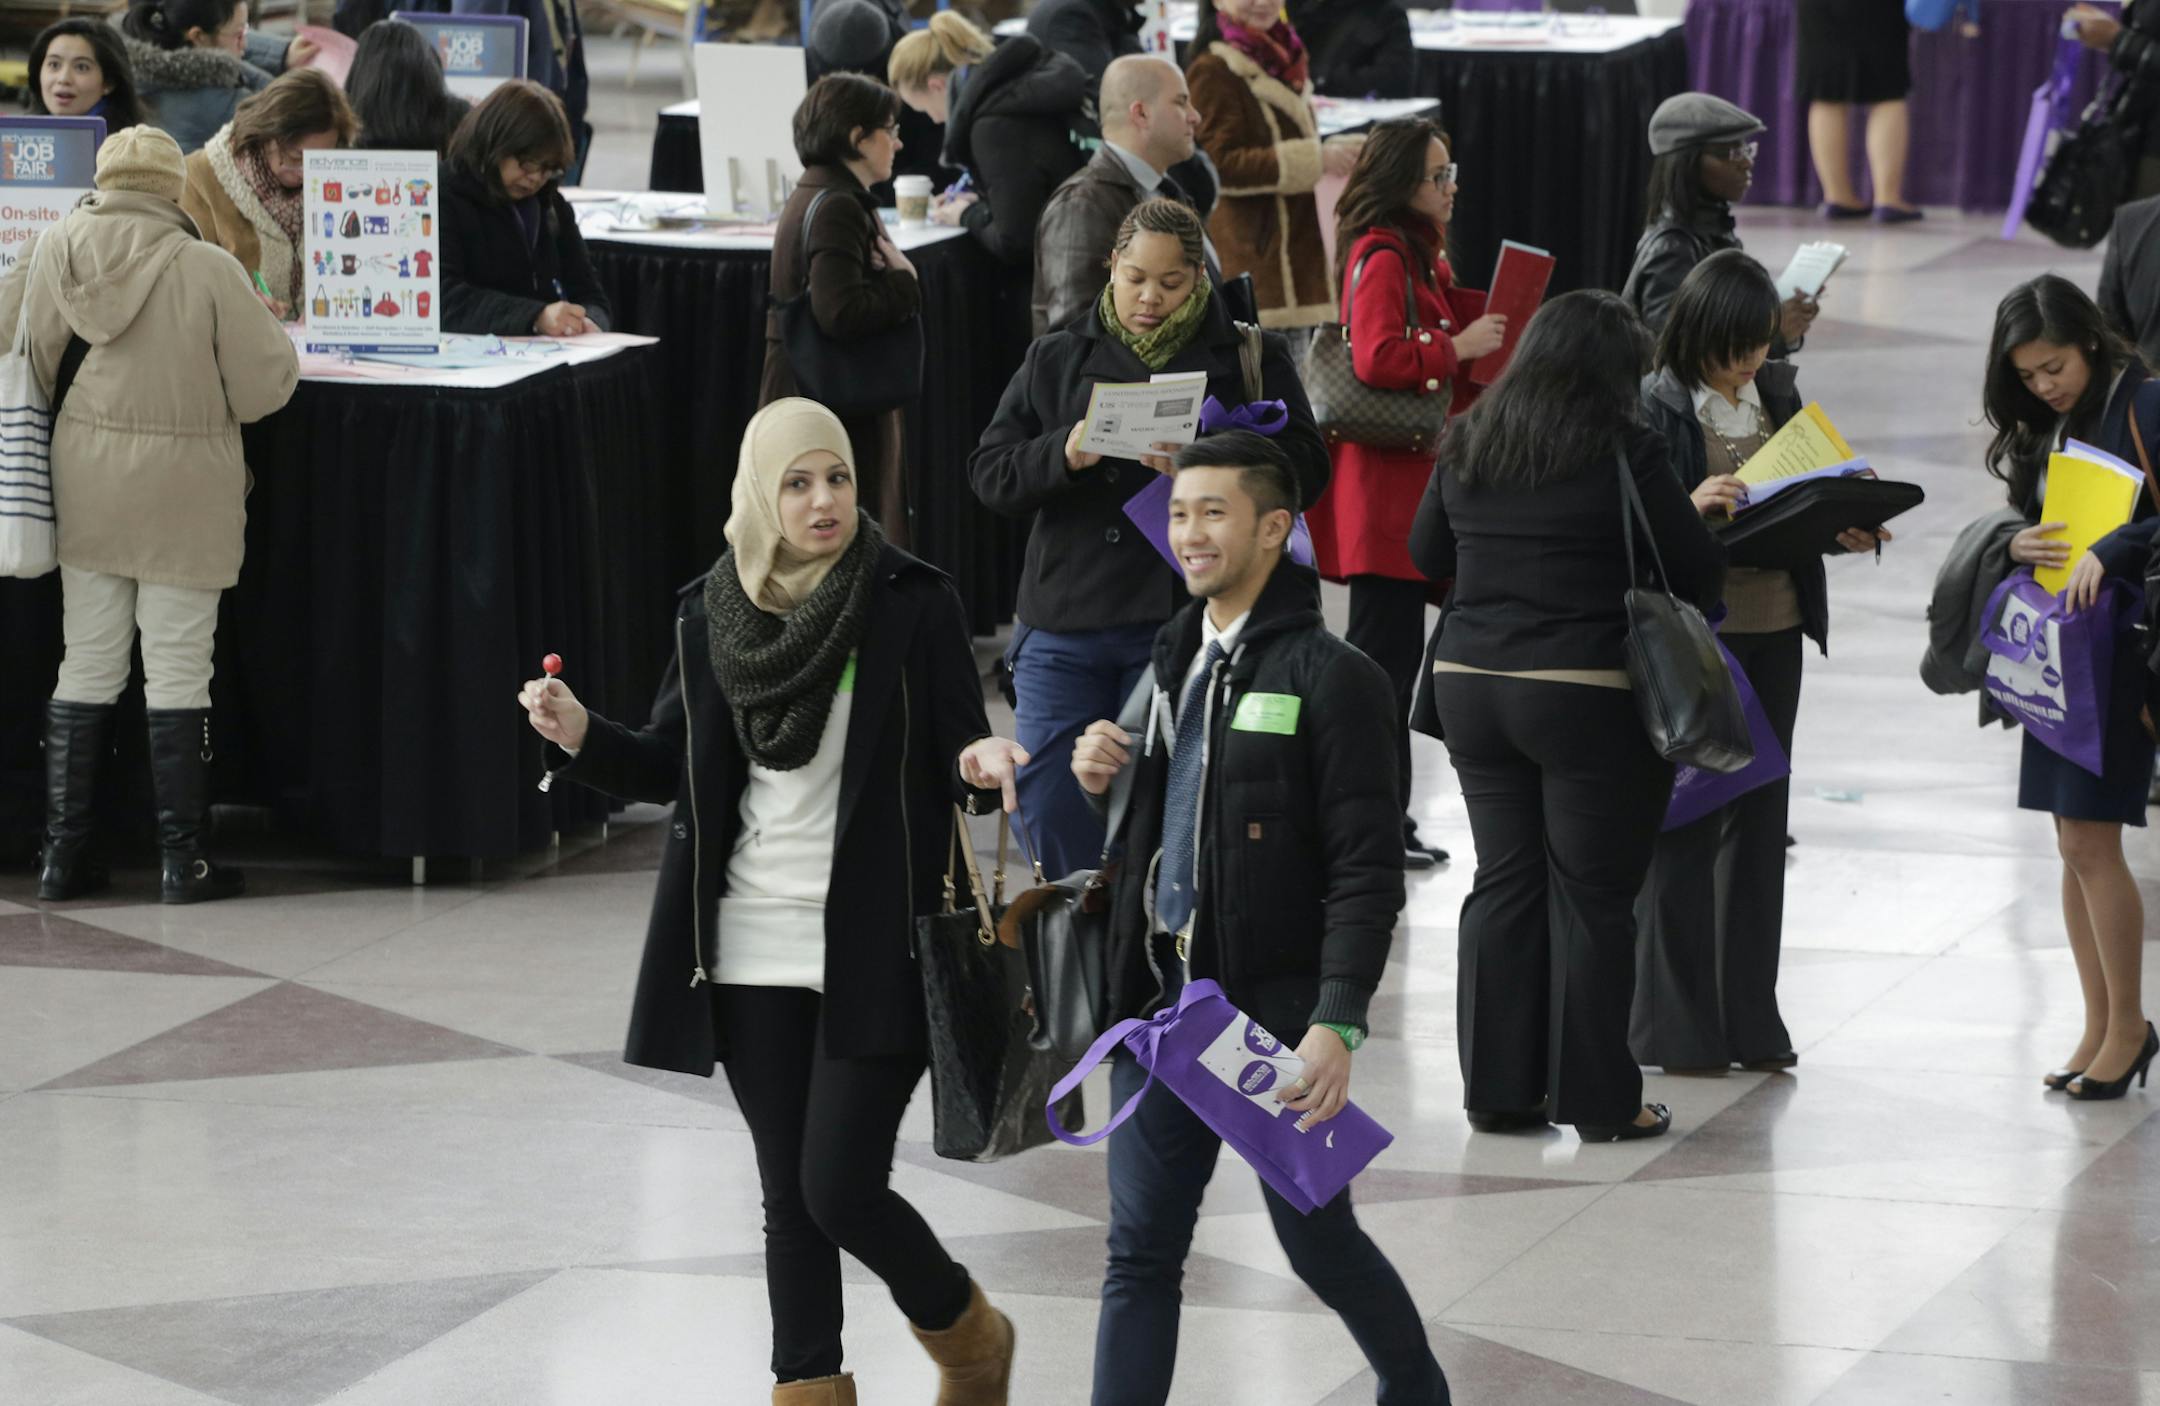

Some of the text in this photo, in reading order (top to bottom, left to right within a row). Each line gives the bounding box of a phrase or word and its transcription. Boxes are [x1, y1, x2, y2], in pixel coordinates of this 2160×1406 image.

[445, 38, 484, 54] JOB
[10, 143, 55, 161] JOB
[13, 161, 47, 175] FAIR
[1, 206, 60, 221] On-site
